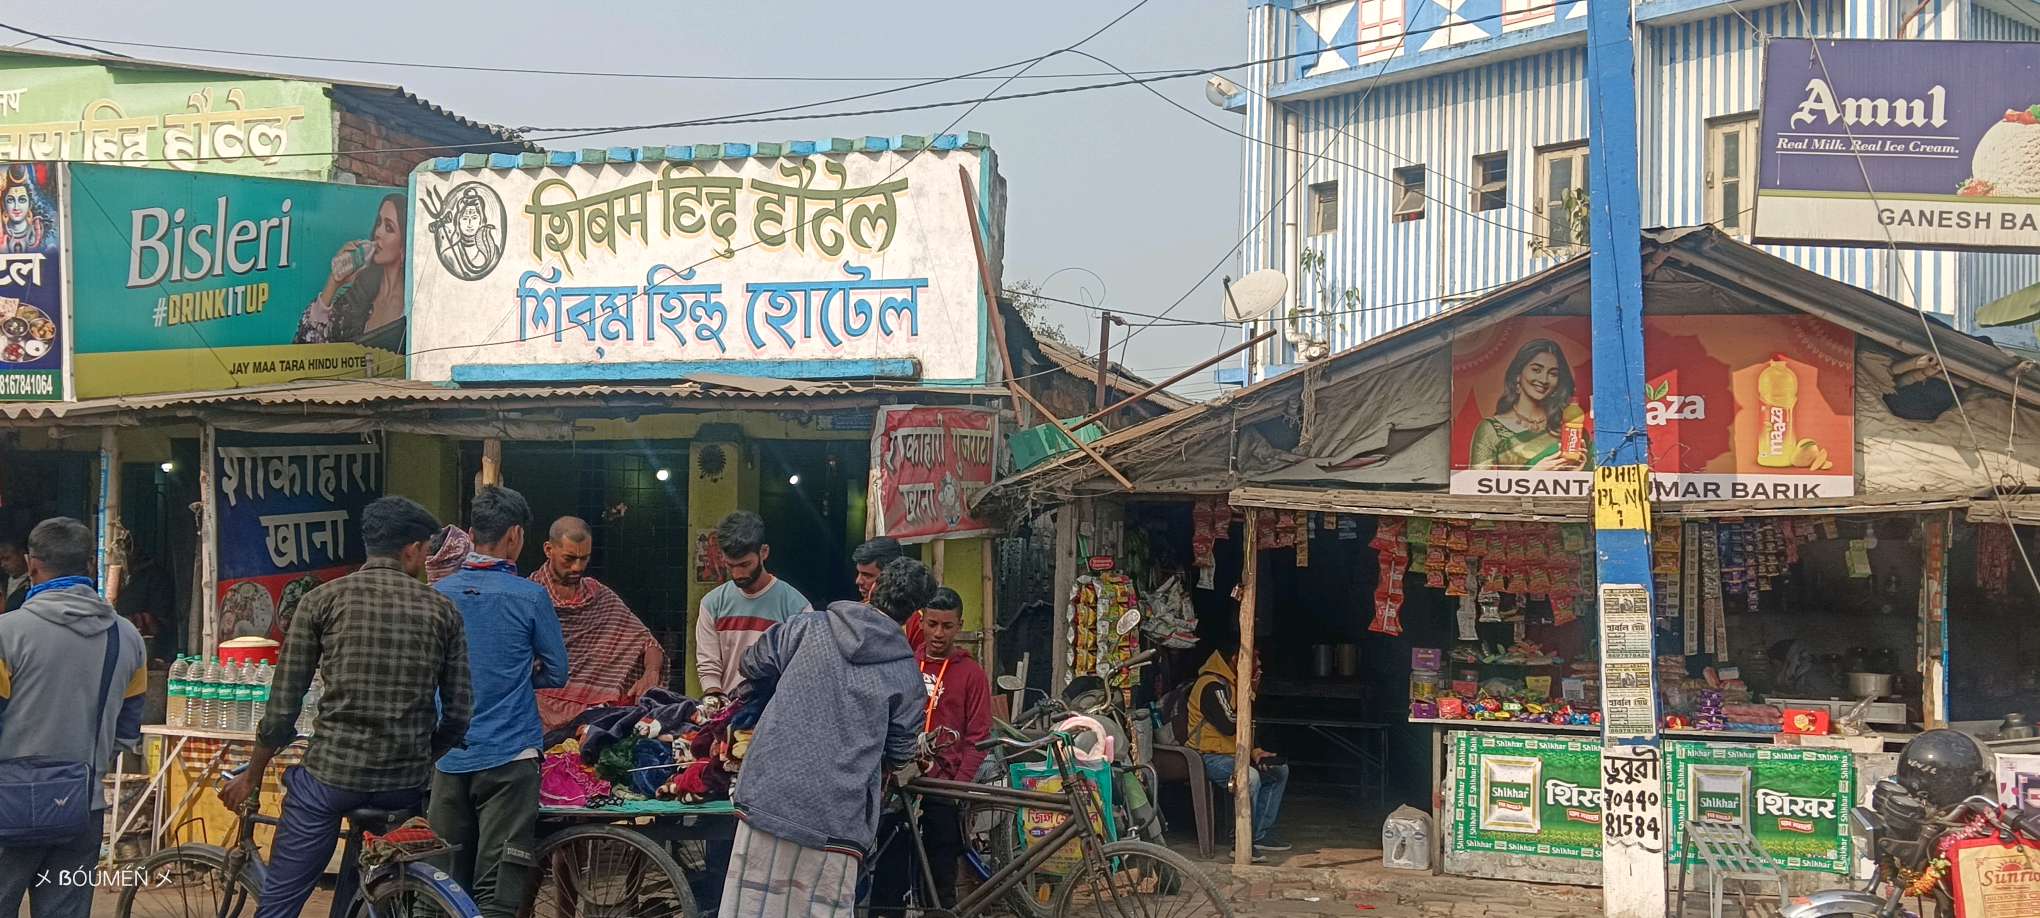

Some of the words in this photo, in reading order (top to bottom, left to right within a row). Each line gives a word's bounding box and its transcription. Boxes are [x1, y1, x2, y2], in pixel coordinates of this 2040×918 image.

[1790, 78, 1948, 130] Amul
[1776, 138, 1807, 150] Real
[1812, 138, 1846, 151] Milk.
[1851, 139, 1882, 152] Real
[1884, 140, 1905, 152] Ice
[1909, 141, 1960, 154] Cream.
[1878, 208, 1992, 230] GANESH
[126, 196, 292, 288] Bisleri
[152, 282, 269, 328] #DRINKITUP
[746, 260, 929, 350] হোটেল
[231, 362, 250, 375] JAY
[252, 360, 276, 374] MAA
[279, 359, 306, 372] TARA
[308, 358, 338, 370] HINDU
[341, 356, 367, 368] HOTE
[1770, 406, 1786, 456] maaza
[1477, 477, 1589, 496] SUSANT
[1731, 482, 1821, 500] BARIK
[259, 510, 350, 568] खाना
[1496, 740, 1523, 748] Shikhar
[1539, 742, 1566, 750] Shikhar
[1772, 752, 1801, 760] Shikhar
[1491, 787, 1529, 799] Shikhar
[1700, 797, 1739, 809] Shikhar
[1755, 788, 1836, 819] शिखर
[1605, 813, 1660, 840] 81584
[1508, 843, 1536, 852] Shikhar
[1552, 847, 1579, 856] Shikhar
[1802, 860, 1831, 868] Shikhar
